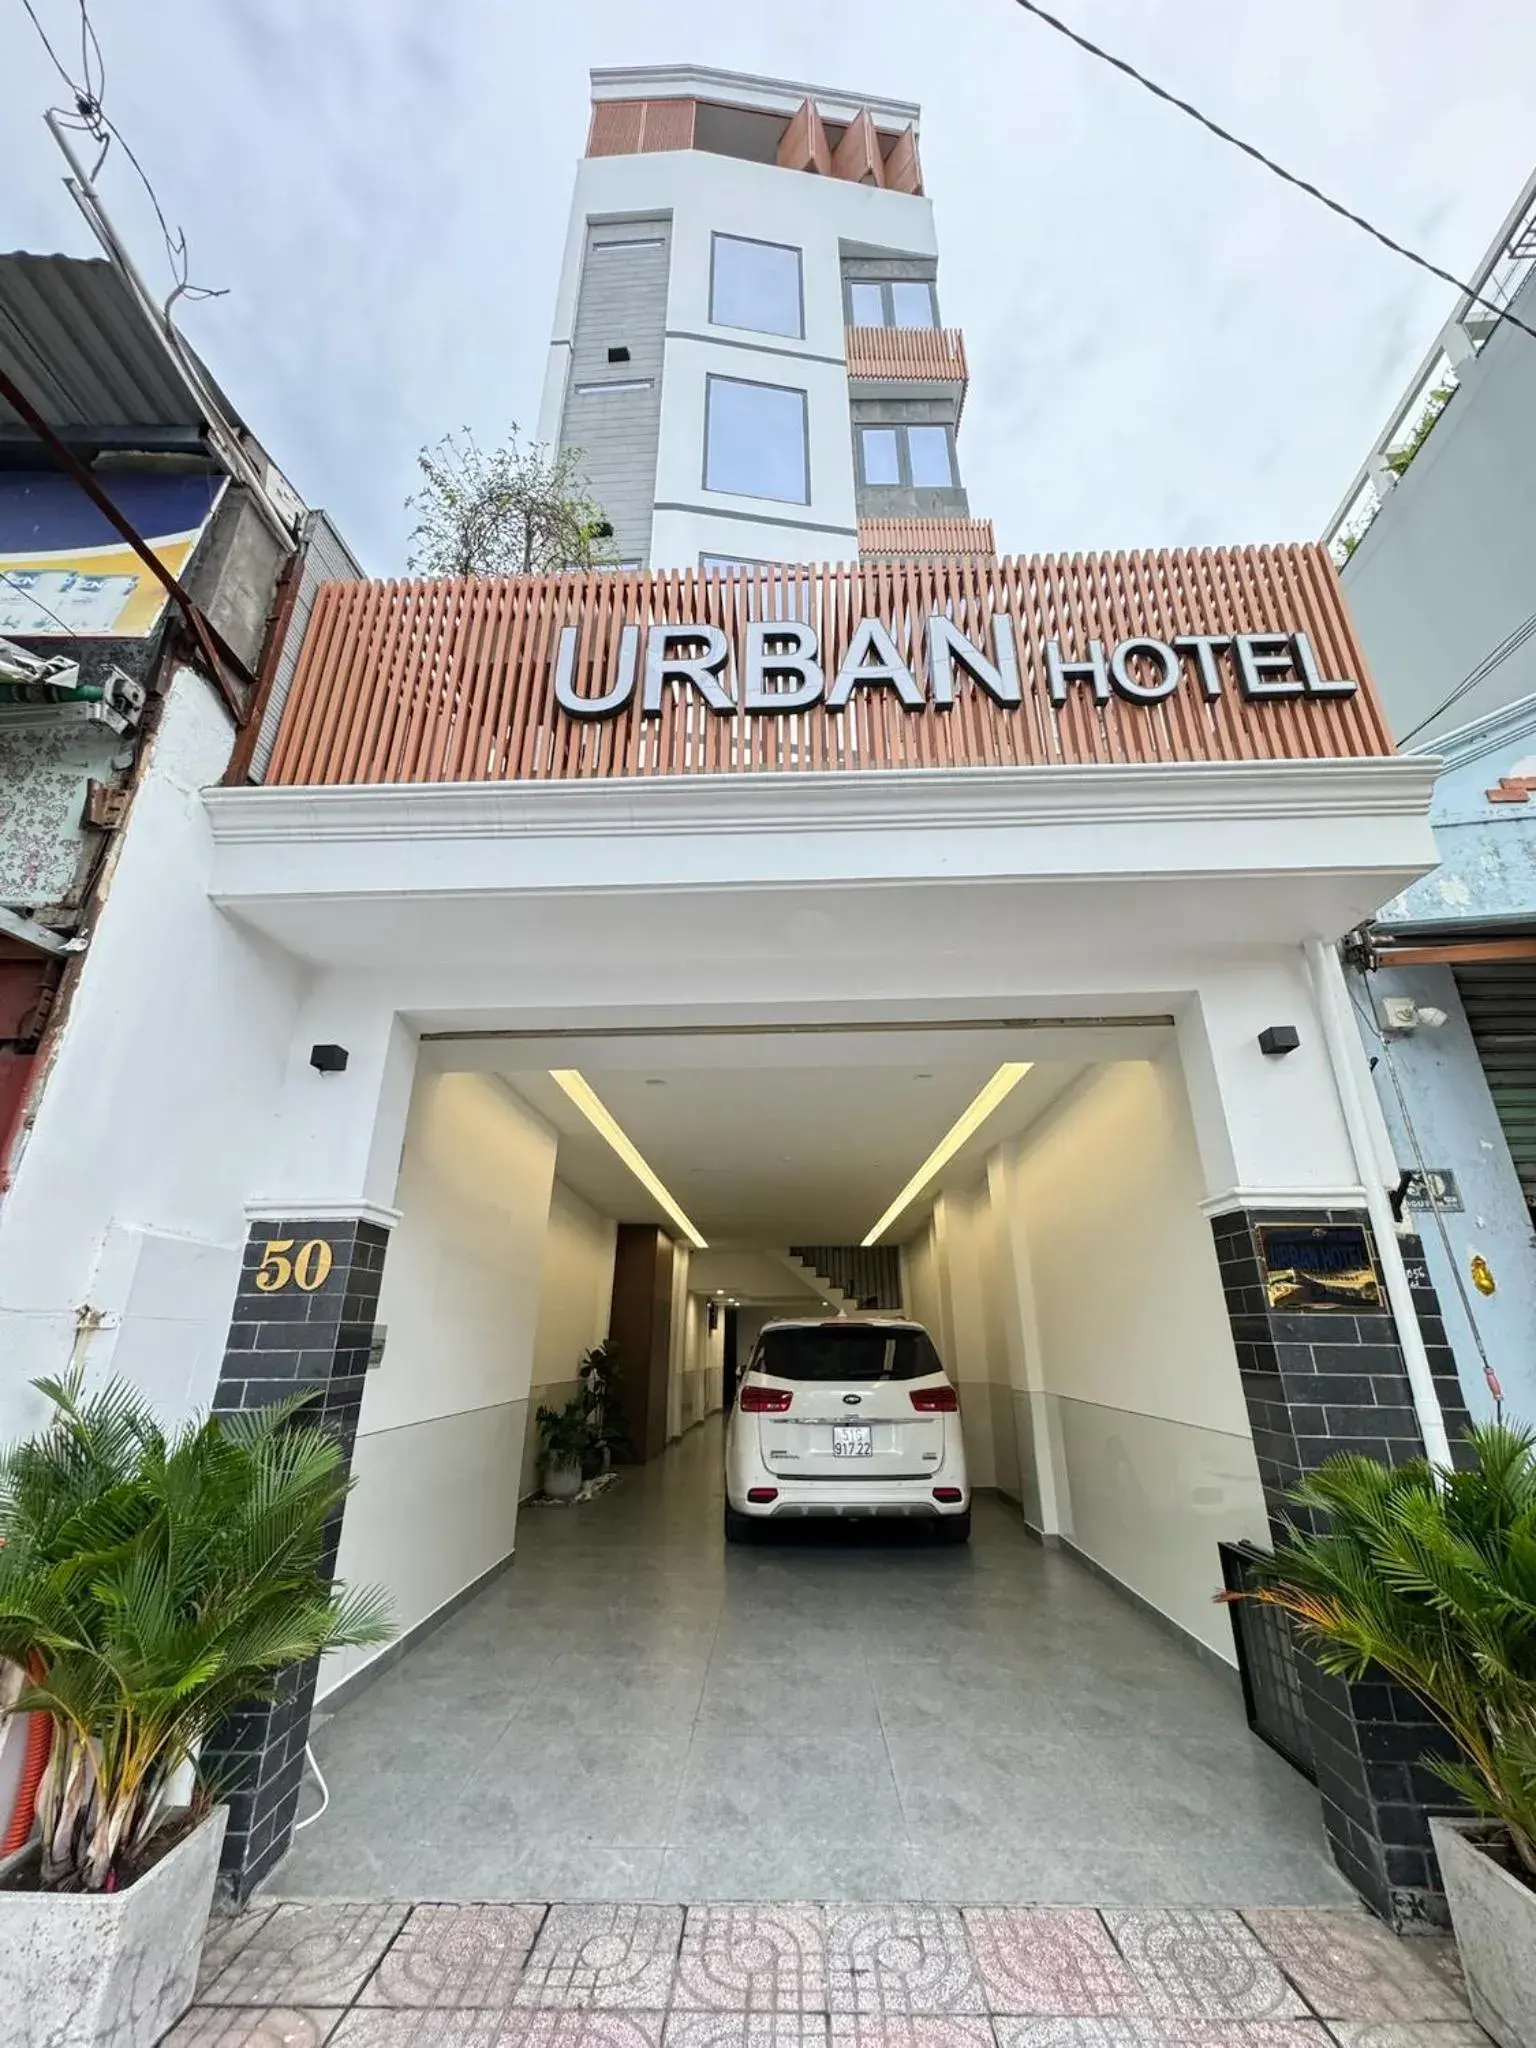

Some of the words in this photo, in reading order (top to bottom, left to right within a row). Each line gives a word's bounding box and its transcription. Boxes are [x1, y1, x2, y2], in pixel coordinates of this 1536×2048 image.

[555, 613, 1021, 721] URBAN
[1046, 631, 1357, 708] HOTEL
[255, 1239, 333, 1293] 50
